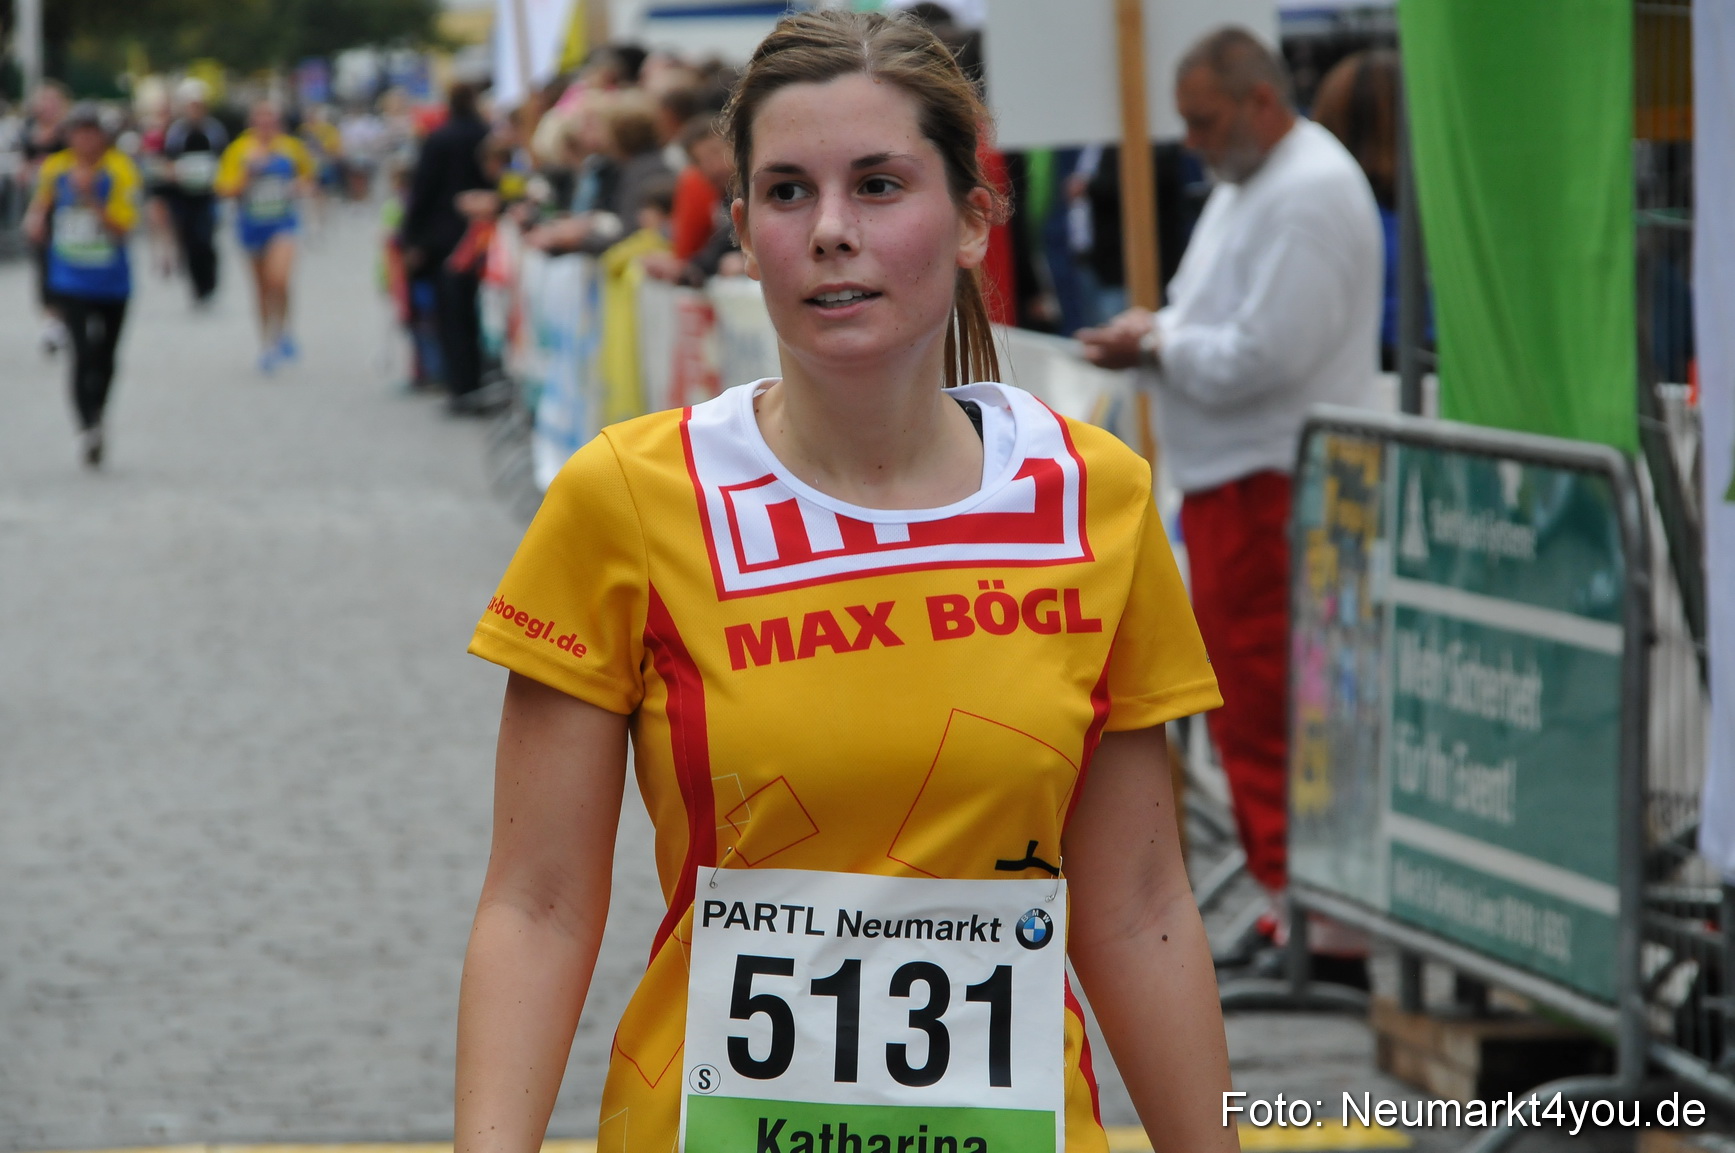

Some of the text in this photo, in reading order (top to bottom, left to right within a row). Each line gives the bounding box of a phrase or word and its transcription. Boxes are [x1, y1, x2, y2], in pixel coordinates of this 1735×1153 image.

[724, 580, 1103, 671] MAX BÖGL
[701, 900, 1002, 943] PARTL Neumarkt
[727, 954, 1013, 1088] 5131
[698, 1069, 712, 1090] S
